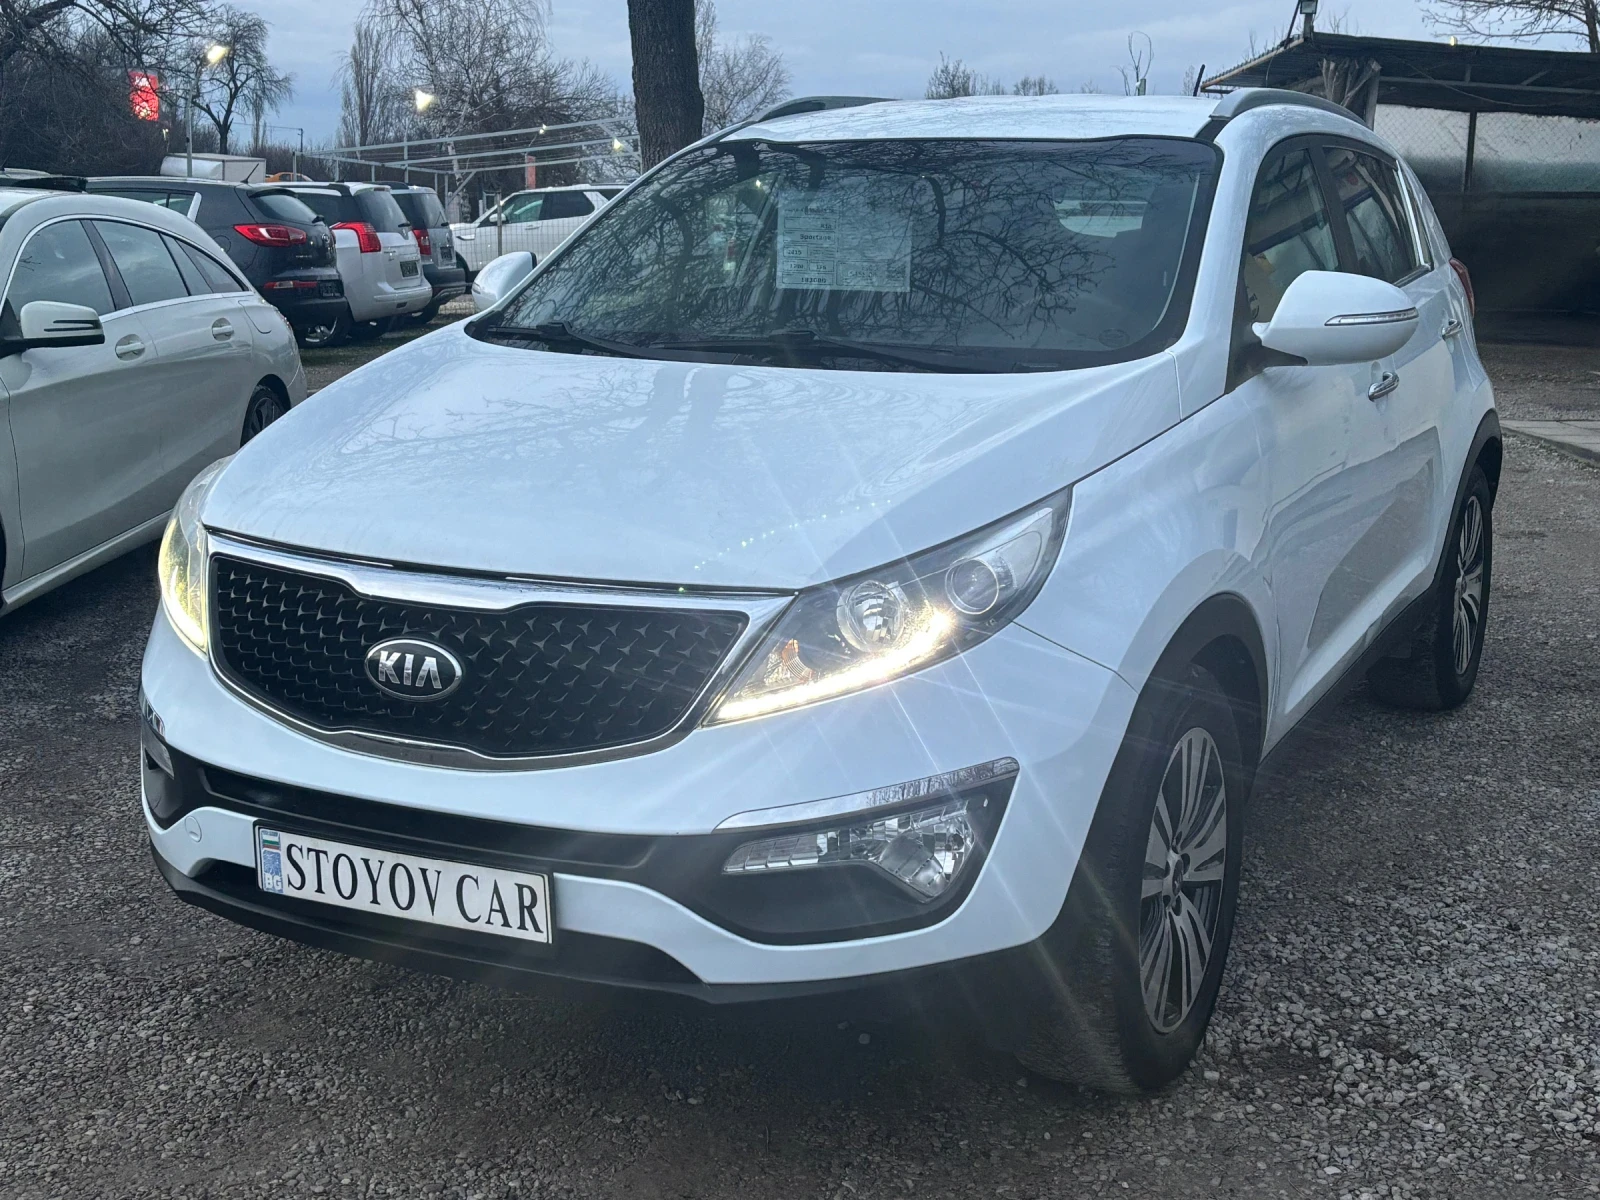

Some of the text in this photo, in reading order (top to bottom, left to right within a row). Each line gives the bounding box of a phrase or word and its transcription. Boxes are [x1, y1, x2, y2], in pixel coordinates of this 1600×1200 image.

[378, 650, 442, 689] KIA
[265, 873, 282, 890] BG
[286, 843, 544, 933] STOYOV CAR
